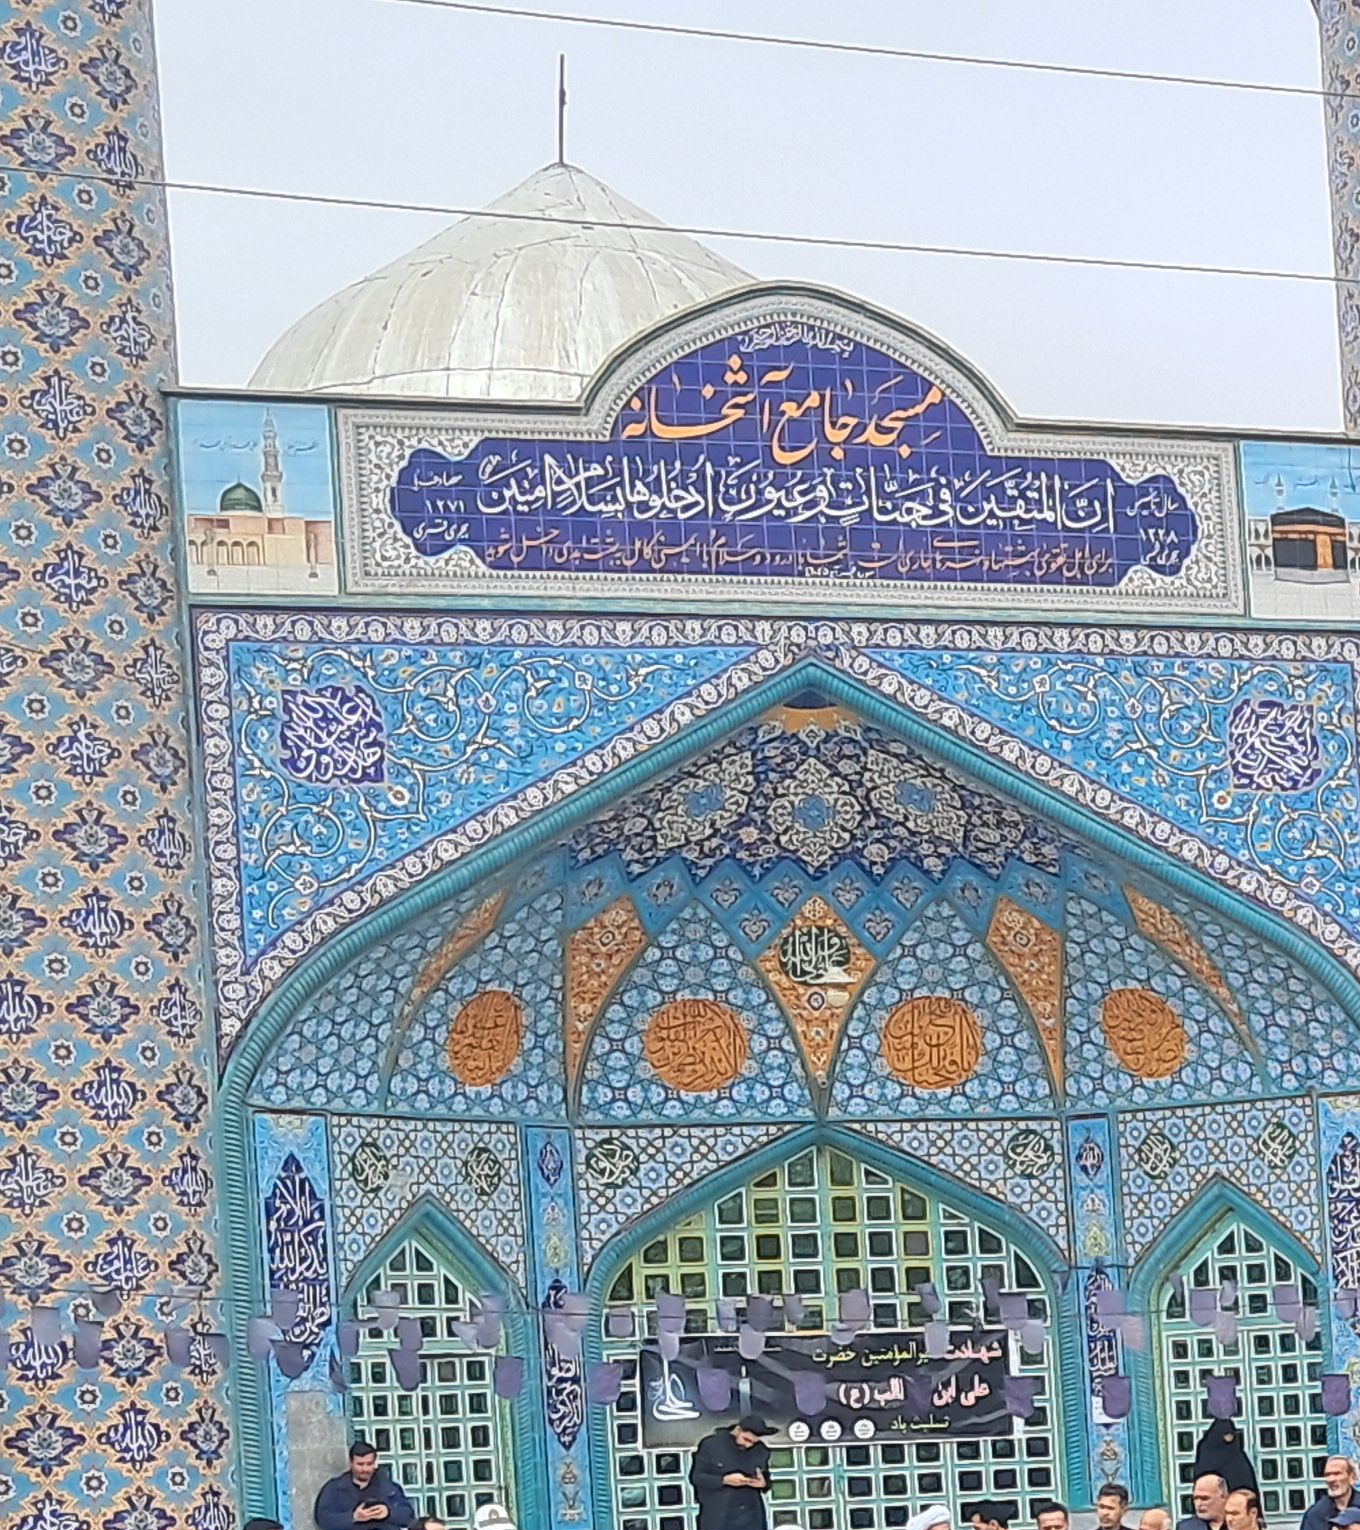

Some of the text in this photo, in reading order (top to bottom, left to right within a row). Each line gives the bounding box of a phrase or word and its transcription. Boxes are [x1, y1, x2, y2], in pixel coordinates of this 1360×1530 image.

[620, 354, 946, 466] مسجد جامع آشخانه
[811, 1347, 856, 1370] حضرت
[943, 1338, 1003, 1362] شهادت
[838, 1381, 871, 1408] (ع)
[931, 1373, 957, 1406] ابن
[959, 1373, 991, 1405] علی
[890, 1413, 951, 1433] تسلیت باد
